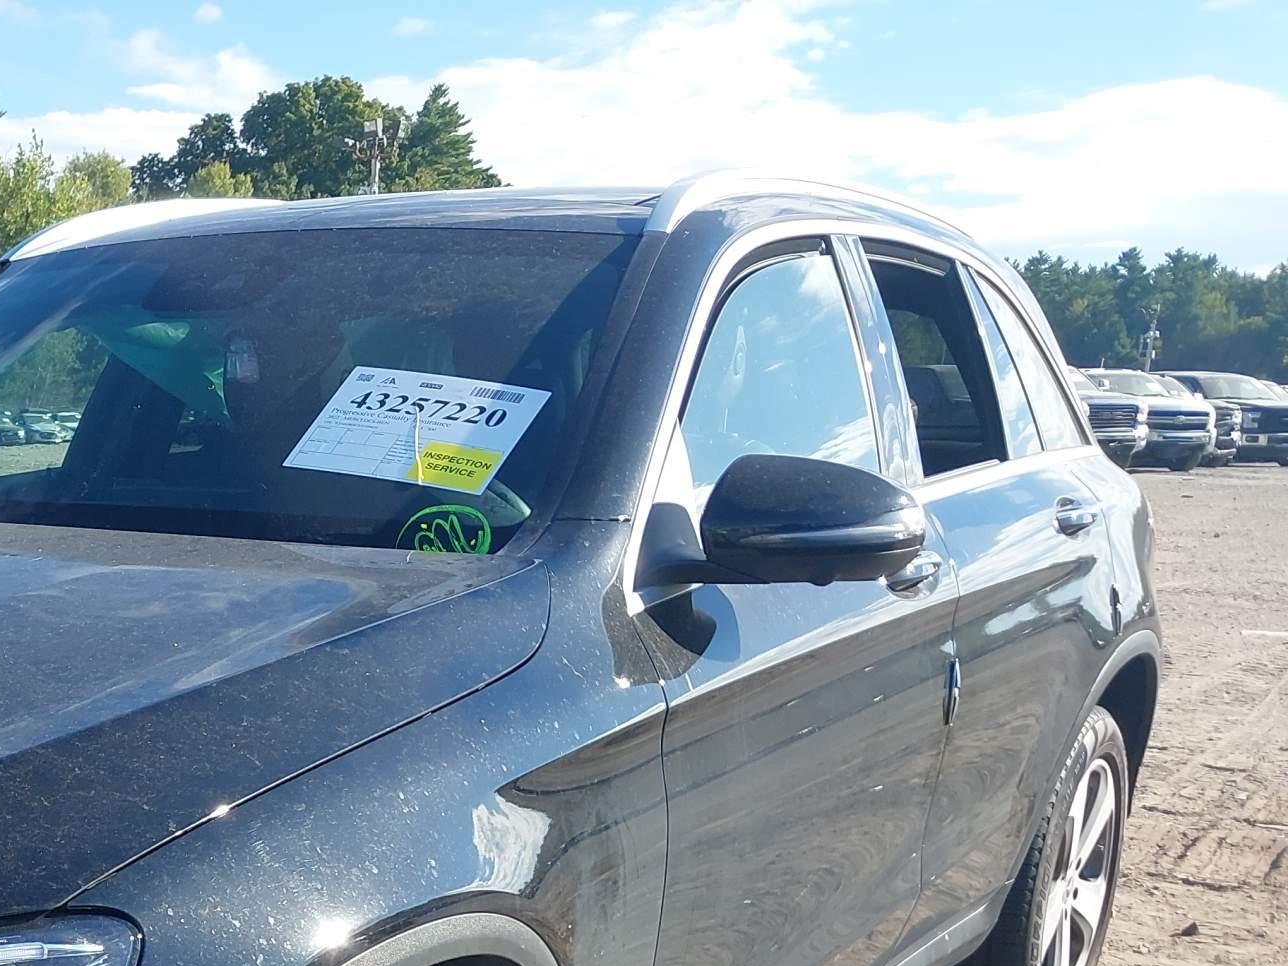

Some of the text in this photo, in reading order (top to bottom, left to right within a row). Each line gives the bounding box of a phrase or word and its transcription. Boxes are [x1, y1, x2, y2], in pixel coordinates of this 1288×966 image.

[331, 407, 376, 418] Progressive
[350, 391, 507, 427] 43257220
[423, 451, 492, 470] INSPECTION
[425, 462, 476, 478] SERVICE
